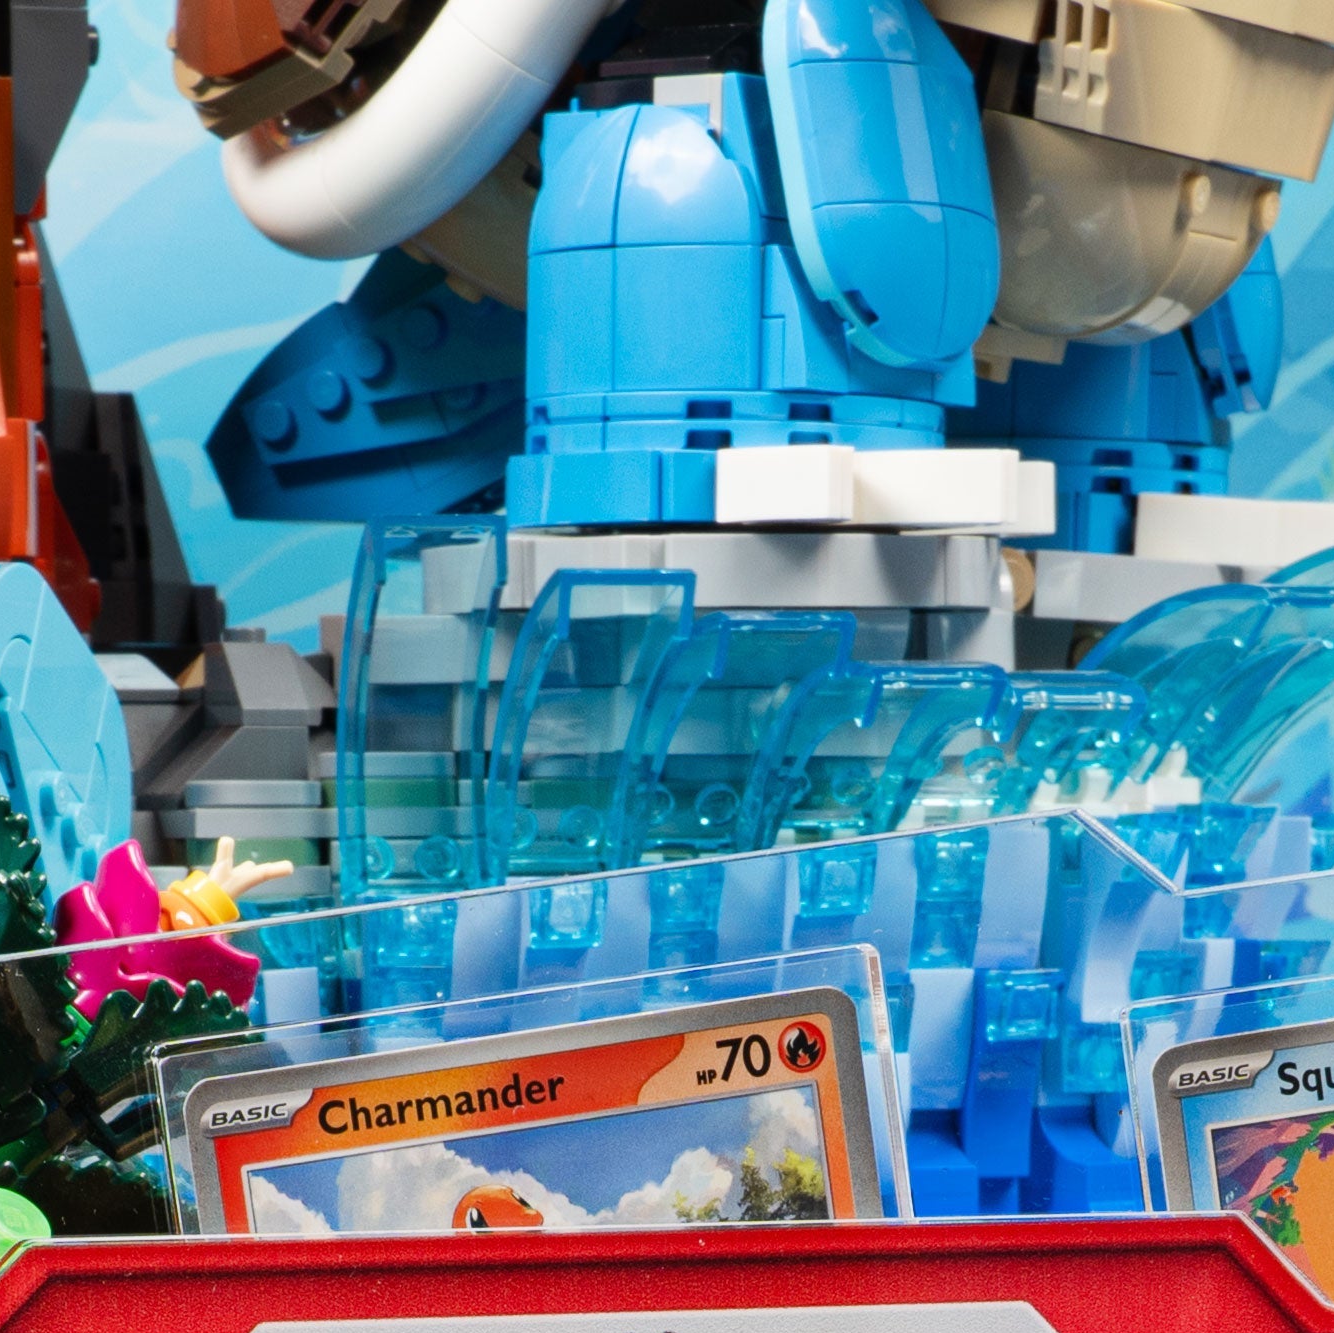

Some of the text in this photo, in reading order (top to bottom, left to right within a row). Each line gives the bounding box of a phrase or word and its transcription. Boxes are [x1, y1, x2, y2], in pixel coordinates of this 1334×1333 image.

[210, 1034, 770, 1134] BASIC Charmander HP 70
[1178, 1064, 1250, 1087] BASIC
